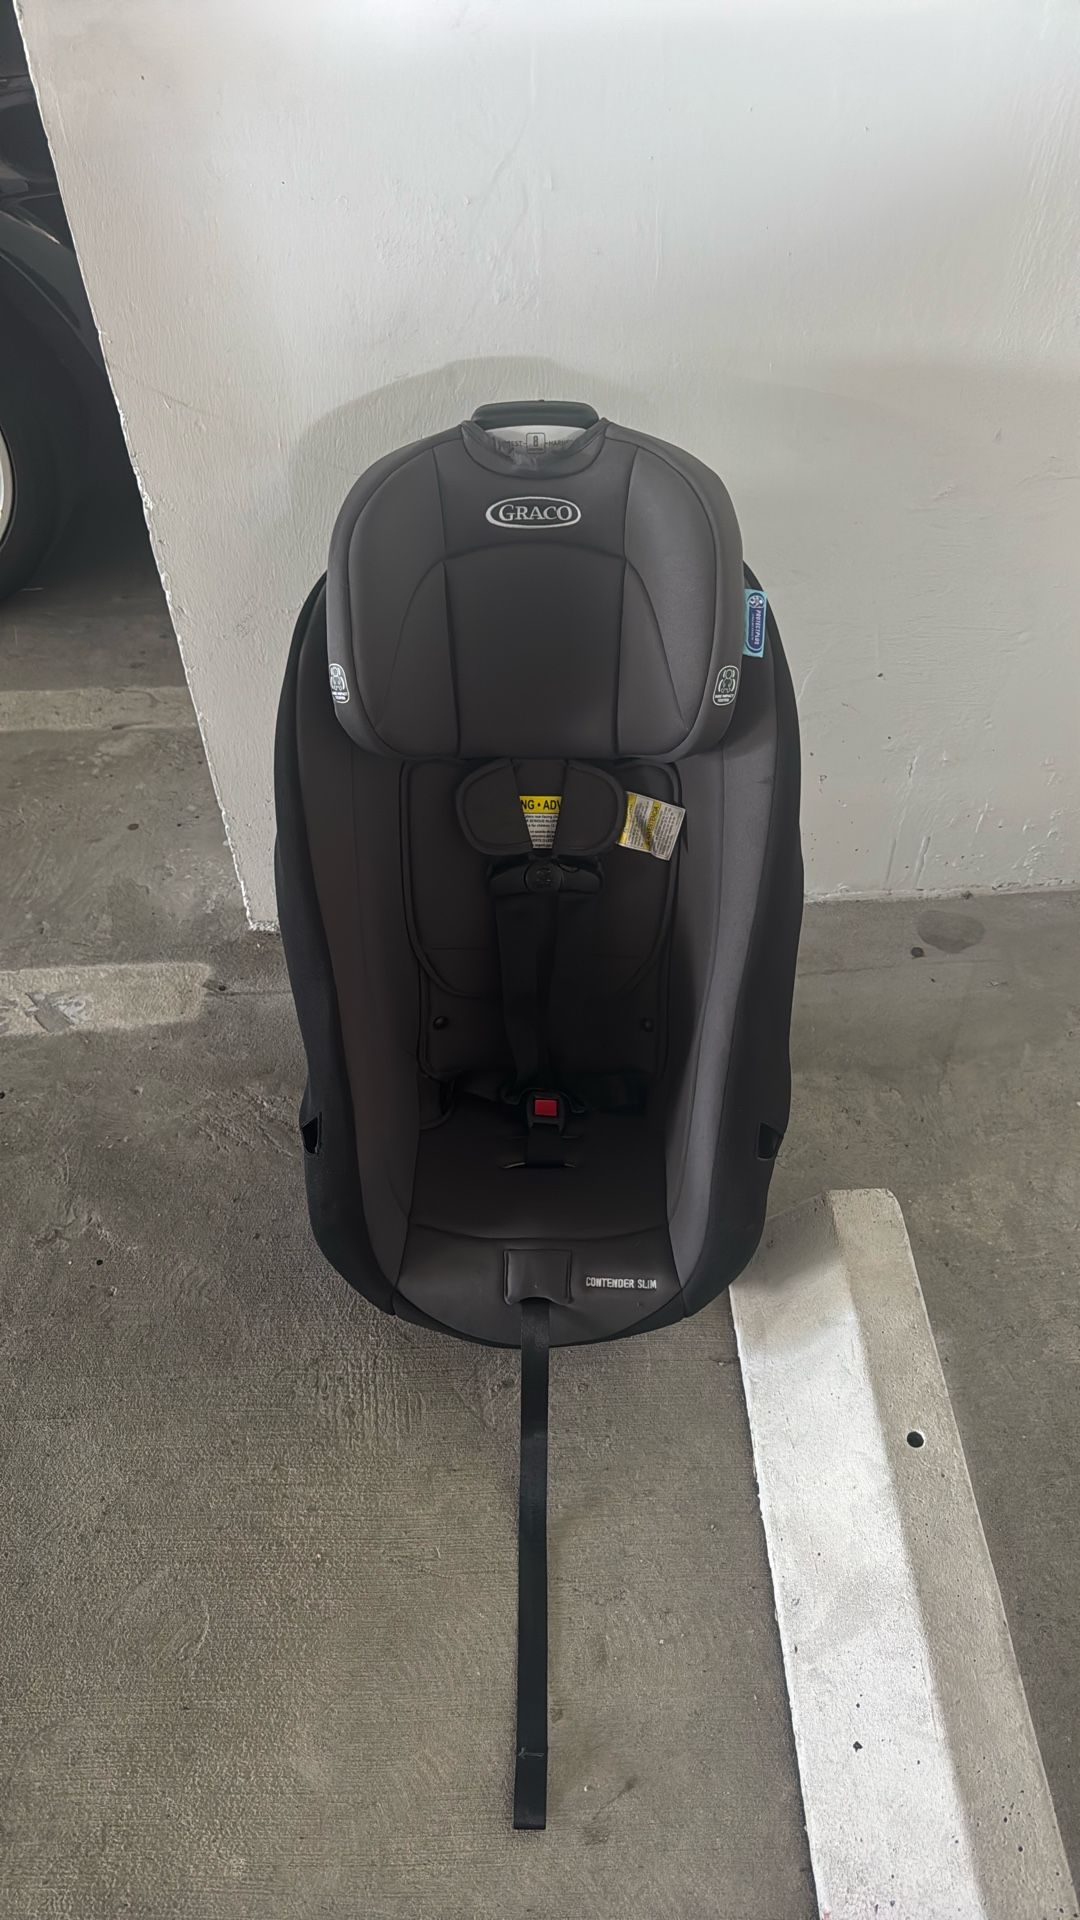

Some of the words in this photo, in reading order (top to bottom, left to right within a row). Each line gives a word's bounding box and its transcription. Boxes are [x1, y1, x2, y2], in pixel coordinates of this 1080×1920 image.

[533, 435, 539, 447] 8
[499, 504, 573, 521] GRACO
[585, 1276, 635, 1289] CONTENDER
[637, 1278, 657, 1289] SLIM
